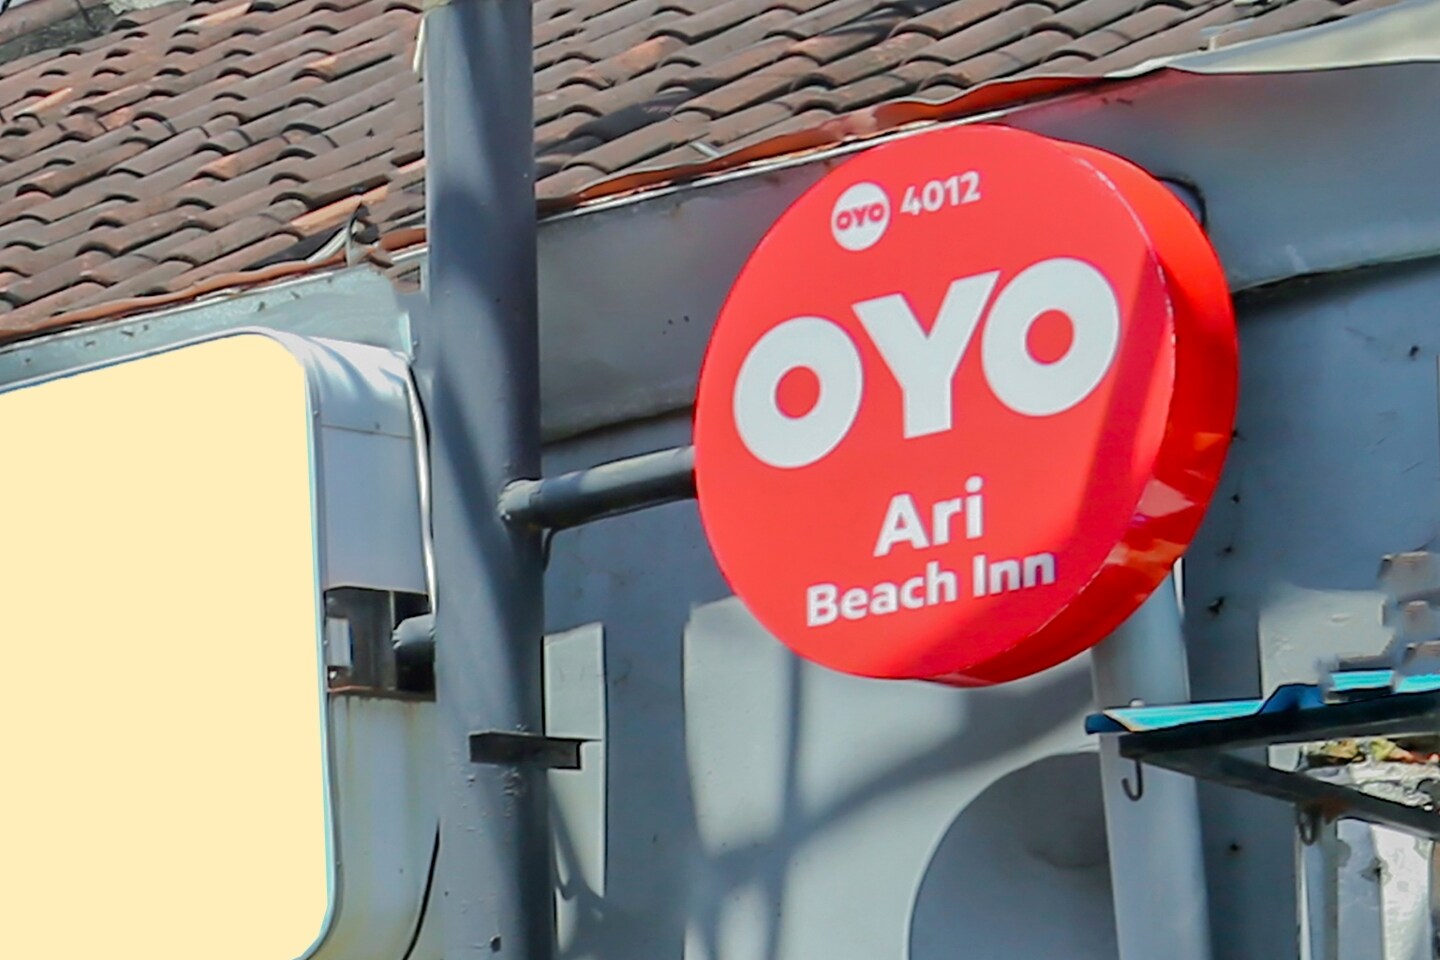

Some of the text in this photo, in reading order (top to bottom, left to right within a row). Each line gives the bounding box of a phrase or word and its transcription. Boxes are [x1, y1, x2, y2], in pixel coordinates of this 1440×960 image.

[835, 171, 981, 232] OYO 4012
[733, 257, 1120, 469] OYO
[873, 475, 984, 557] Ari
[806, 550, 1056, 627] Beach Inn
